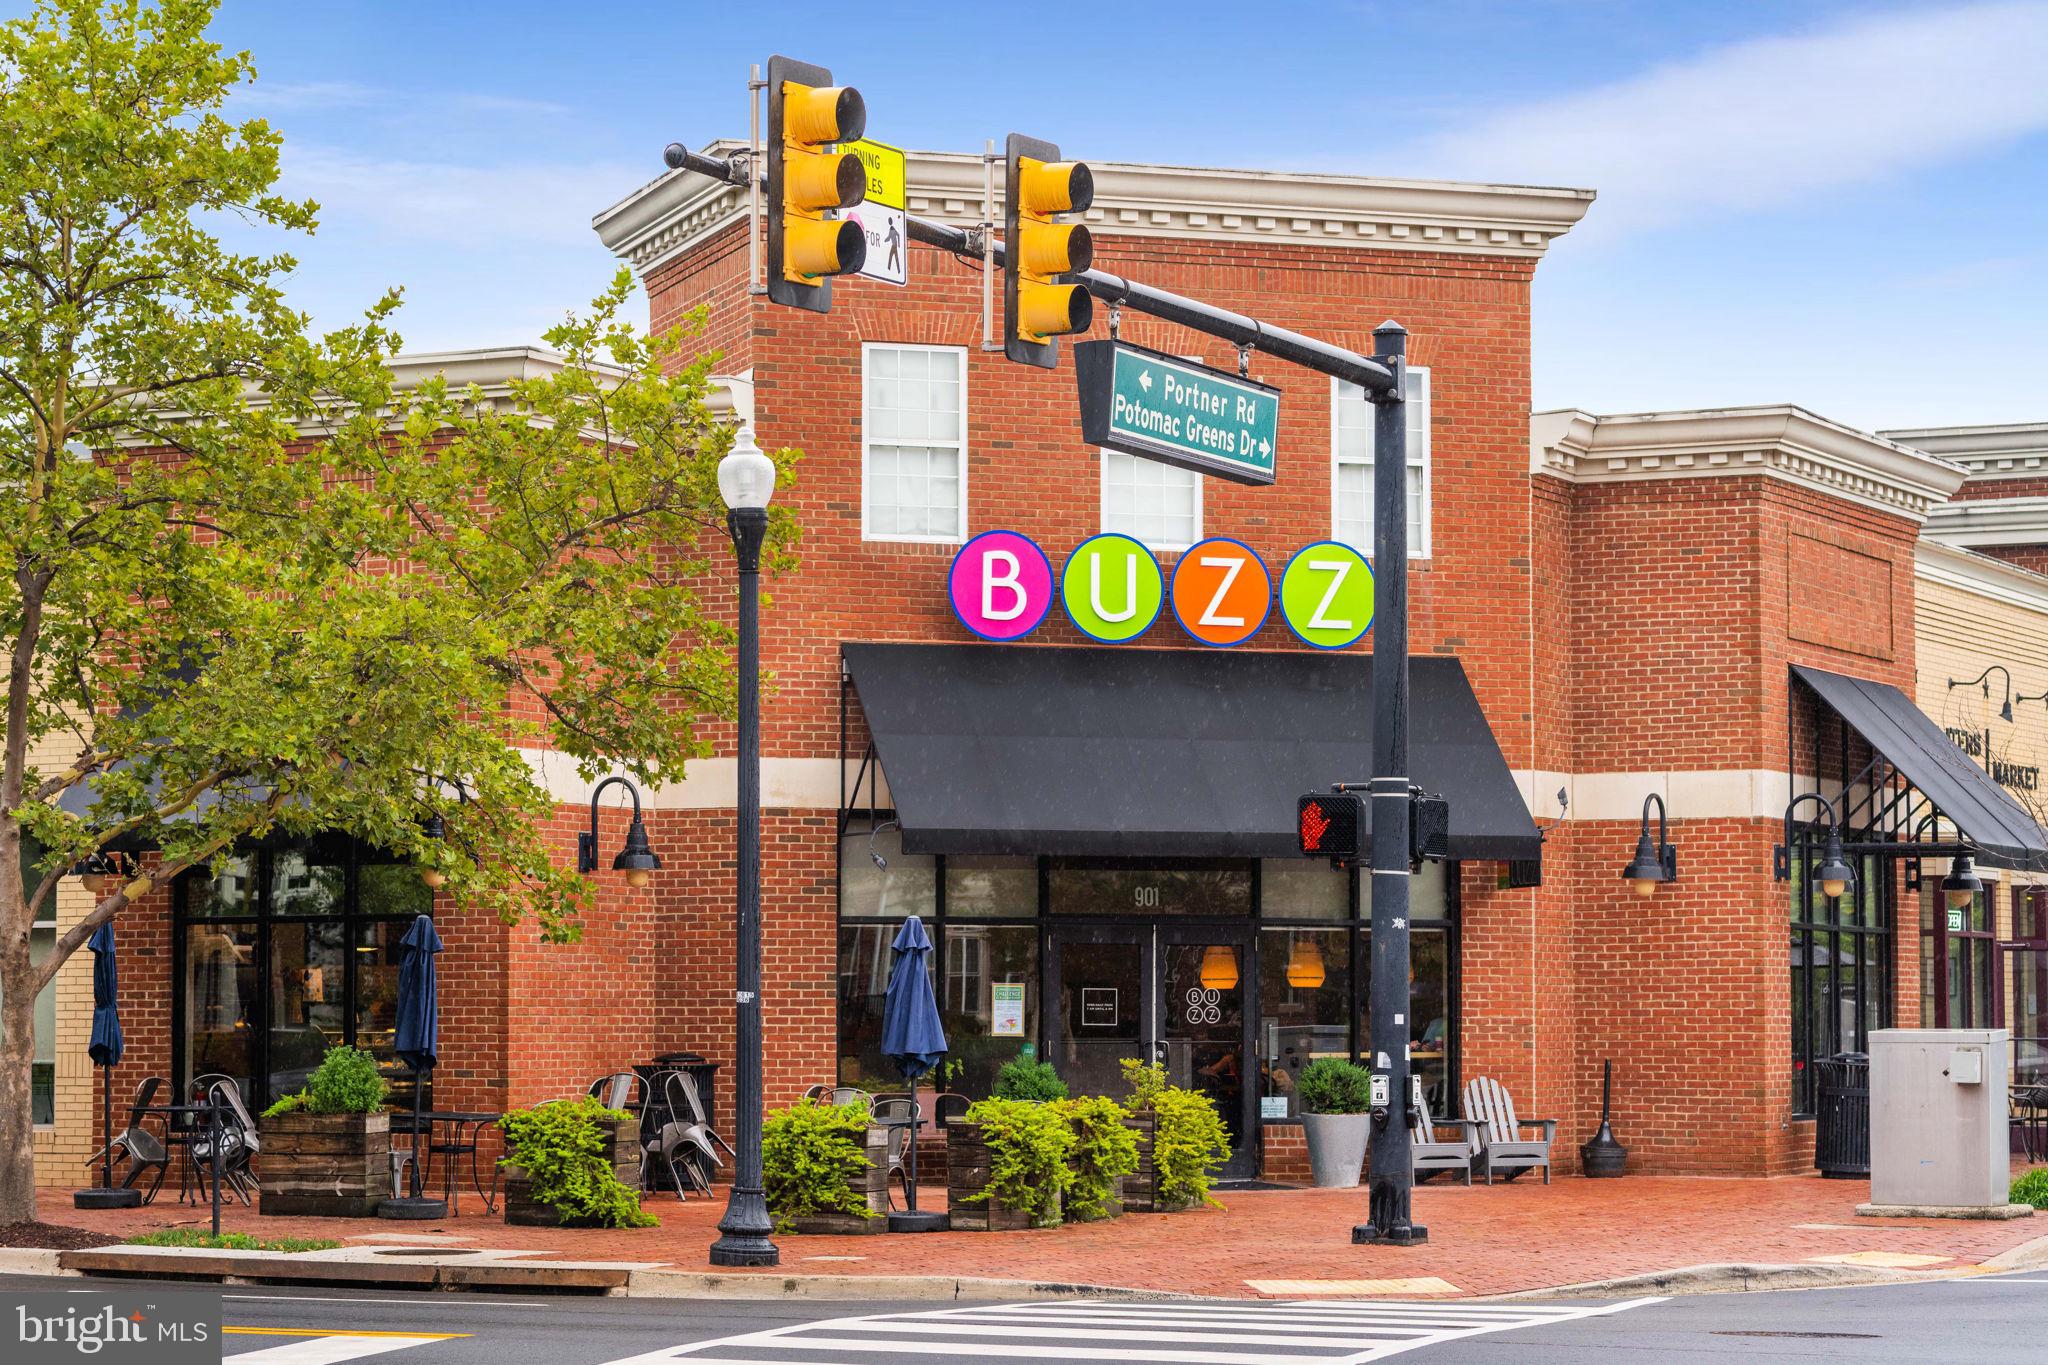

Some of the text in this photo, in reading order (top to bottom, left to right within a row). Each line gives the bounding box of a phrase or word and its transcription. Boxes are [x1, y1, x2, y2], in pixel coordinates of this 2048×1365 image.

[866, 230, 881, 248] FOR
[1164, 374, 1256, 425] Portner Rd
[1114, 393, 1257, 458] Potomac Greens Dr
[981, 550, 1353, 630] BUZZ
[1945, 727, 1982, 756] TERS
[1992, 761, 2039, 790] MARKET
[1134, 886, 1159, 907] 901
